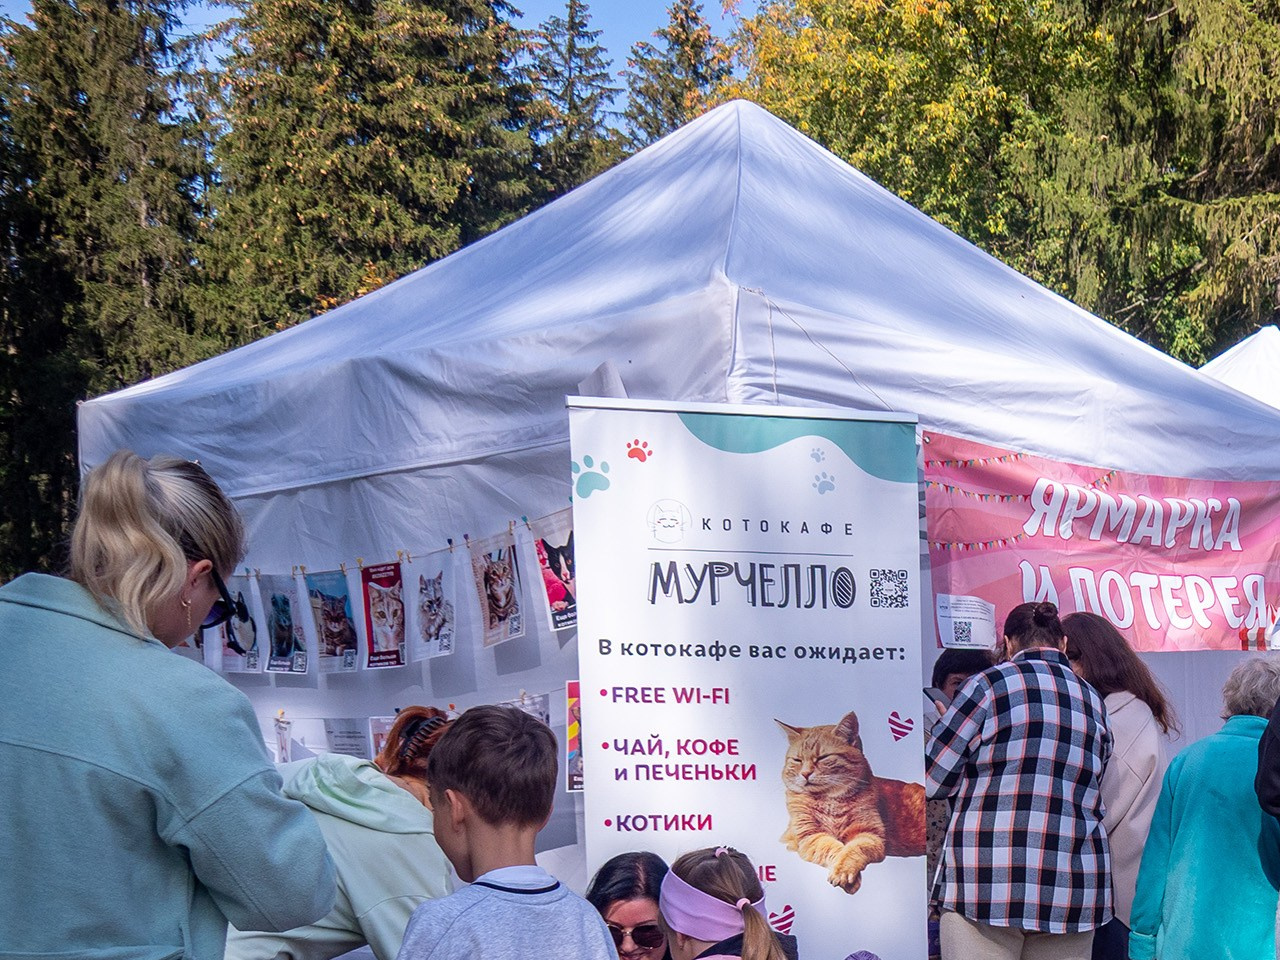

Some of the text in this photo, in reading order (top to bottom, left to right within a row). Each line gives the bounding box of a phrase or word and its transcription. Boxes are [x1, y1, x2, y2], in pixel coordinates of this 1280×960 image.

[1022, 477, 1243, 551] ЯРМАРКА
[702, 518, 853, 536] КОТОКАФЕ
[648, 561, 857, 609] МУРЧЕЛЛО
[599, 639, 906, 664] В котокафе вас ожидает:
[611, 686, 730, 704] FREE WI-FI
[613, 733, 739, 759] ЧАЙ, КОФЕ
[614, 763, 757, 781] и ПЕЧЕНЬКИ
[616, 814, 713, 832] КОТИКИ
